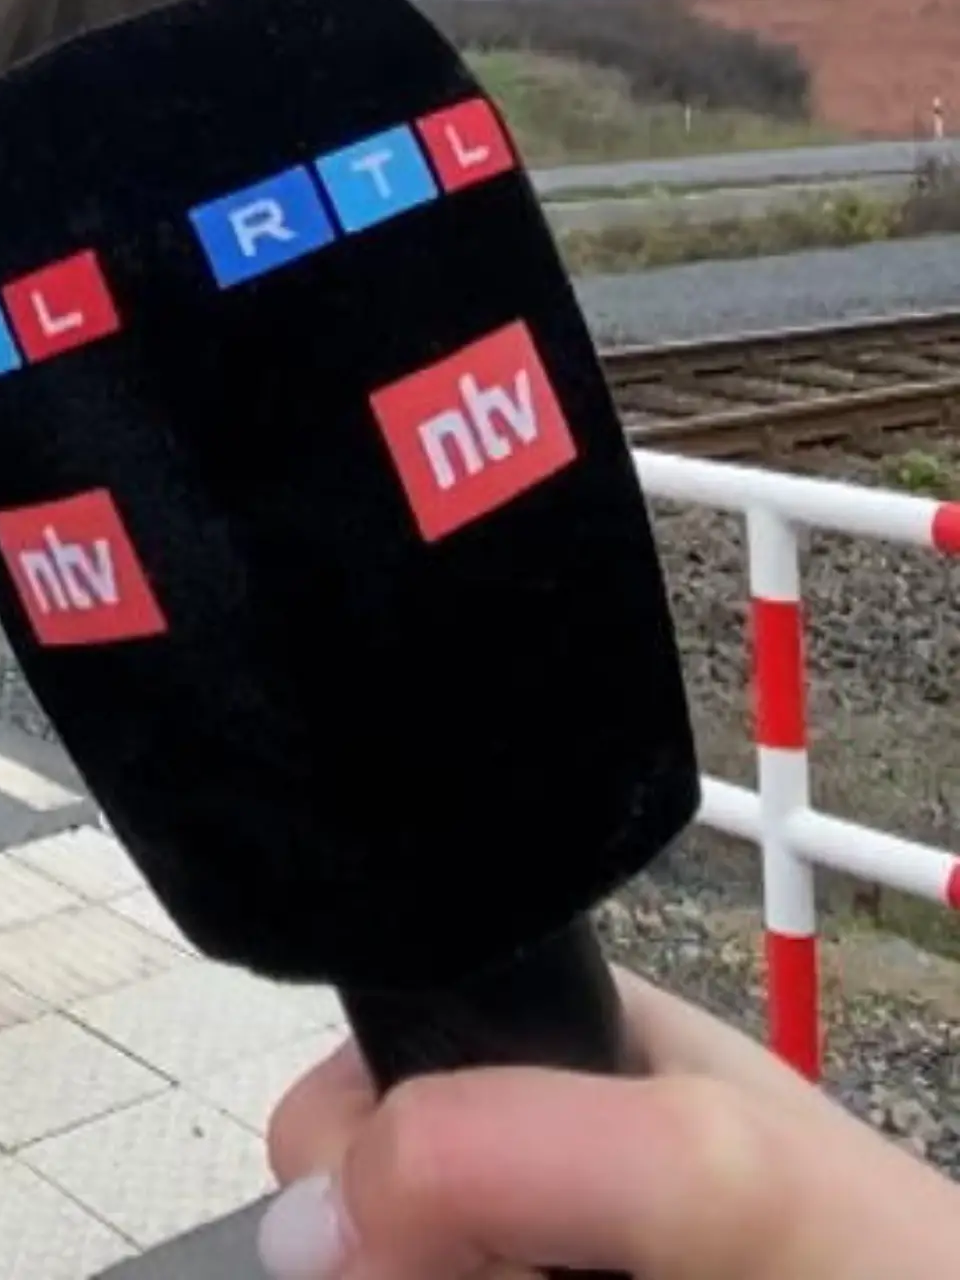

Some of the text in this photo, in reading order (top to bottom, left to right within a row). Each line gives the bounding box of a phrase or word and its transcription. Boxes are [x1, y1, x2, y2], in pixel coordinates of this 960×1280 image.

[225, 121, 492, 258] RTL
[416, 367, 539, 491] ntv
[18, 523, 121, 615] ntv
